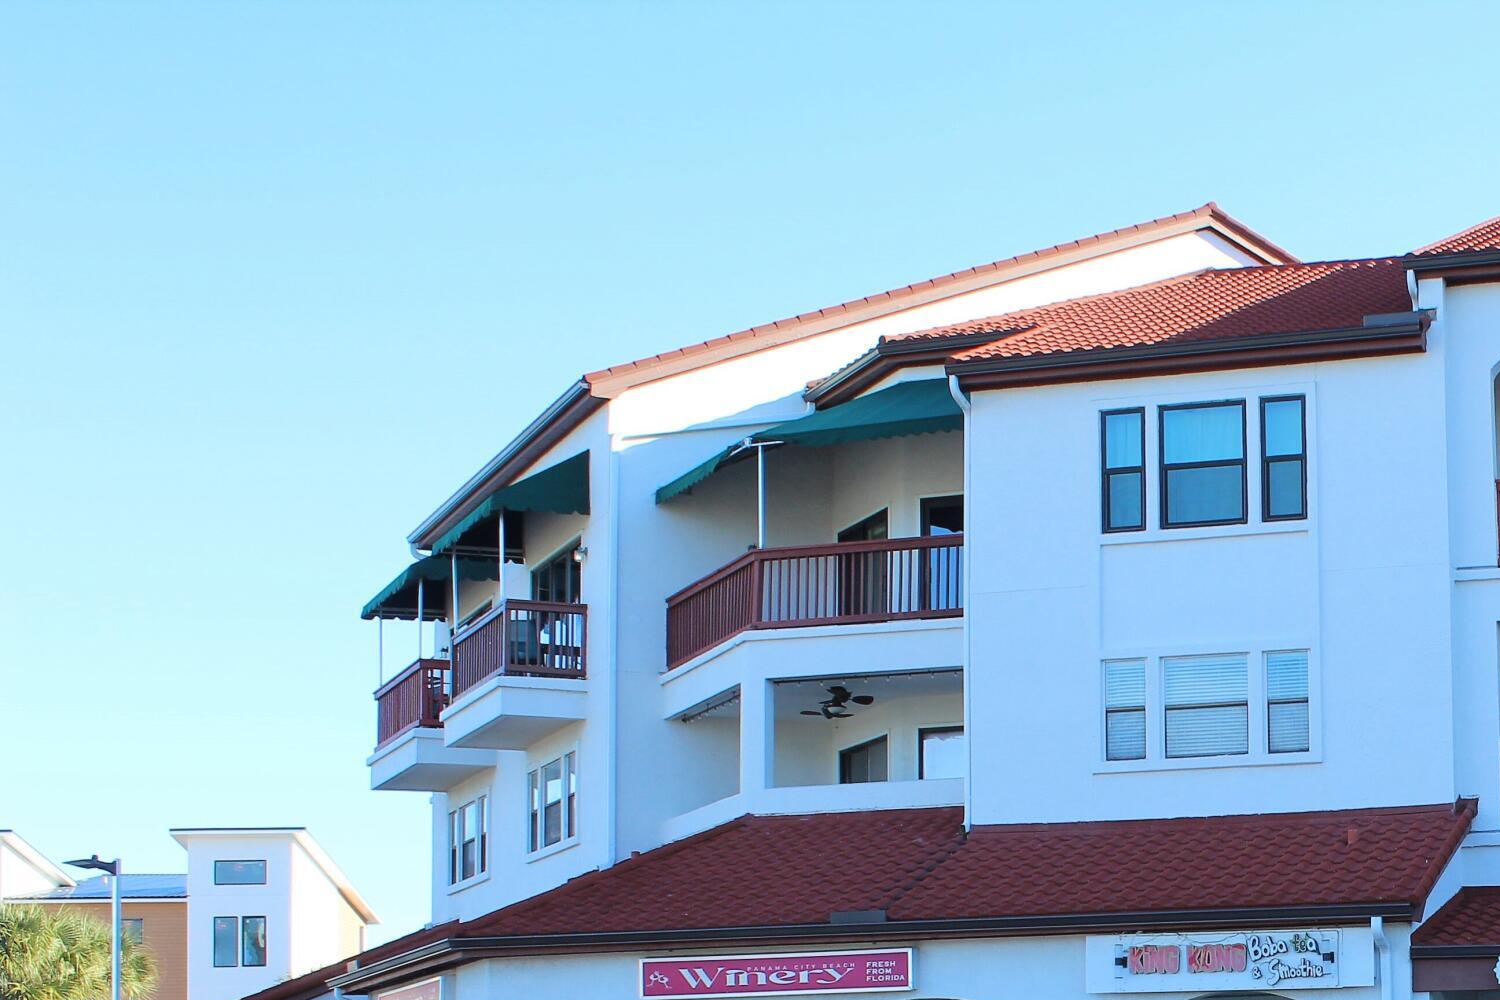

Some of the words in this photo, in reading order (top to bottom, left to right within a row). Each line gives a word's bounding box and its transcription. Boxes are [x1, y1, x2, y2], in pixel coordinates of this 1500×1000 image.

[1187, 943, 1248, 974] KONG
[1249, 934, 1288, 963] Boba
[865, 960, 897, 968] FRESH
[865, 967, 892, 975] FROM
[1251, 967, 1263, 980] &
[1266, 957, 1325, 987] Smoothie
[678, 966, 853, 990] Winery
[865, 974, 905, 983] FLORIDA
